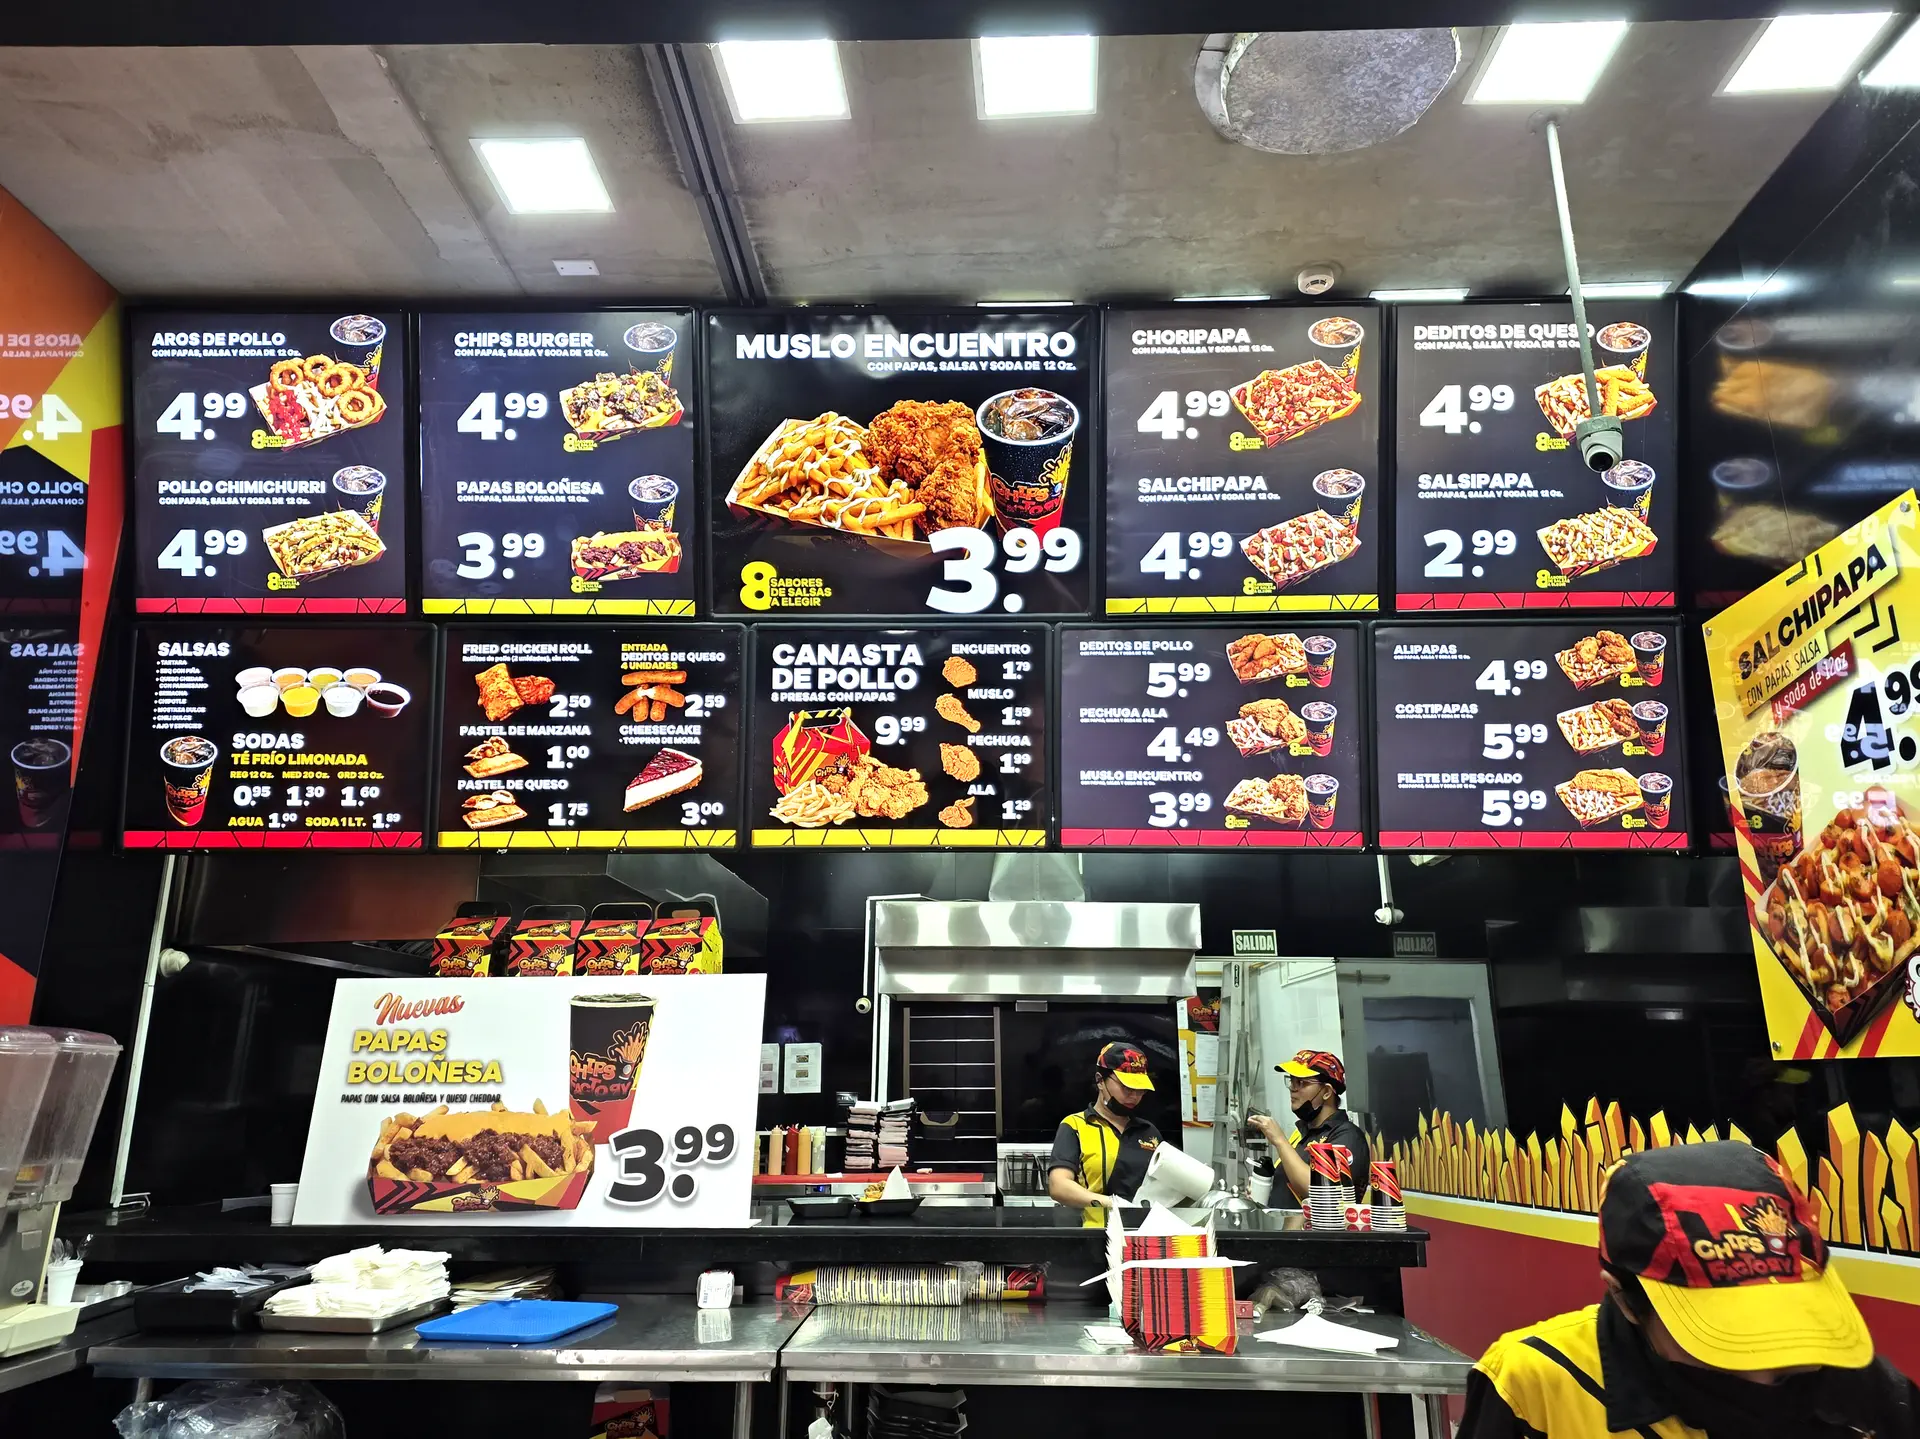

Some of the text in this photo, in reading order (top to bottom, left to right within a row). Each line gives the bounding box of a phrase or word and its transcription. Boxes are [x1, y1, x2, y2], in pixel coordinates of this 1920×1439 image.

[1132, 328, 1251, 346] CHORIPAPA
[1414, 323, 1594, 341] DEDITOS DE QUESO
[152, 333, 286, 346] AROS DE POLLO
[455, 333, 594, 347] CHIPS BURGER
[737, 331, 1075, 360] MUSLO ENCUENTRO
[867, 362, 893, 372] CON
[895, 360, 938, 372] PAPAS,
[939, 361, 977, 371] SALSA
[979, 361, 988, 370] Y
[990, 361, 1022, 371] SODA
[1024, 361, 1040, 370] DE
[1044, 361, 1056, 370] 12
[159, 481, 326, 494] POLLO CHIMICHURRI
[457, 478, 604, 494] PAPAS BOLOÑESA
[1138, 476, 1267, 494] SALCHIPAPA
[1418, 473, 1533, 489] SALSIPAPA
[740, 562, 777, 610] 8
[771, 579, 823, 587] SABORES
[770, 588, 832, 598] DE SALSAS
[770, 597, 820, 606] A ELEGIR
[1738, 543, 1887, 680] SALCHIPAPA
[158, 642, 230, 656] SALSAS
[463, 644, 592, 654] FRIED CHICKEN ROLL
[952, 644, 1031, 654] ENCUENTRO
[1080, 641, 1193, 652] DEDITOS DE POLLO
[1394, 645, 1457, 656] ALIPAPAS
[621, 652, 725, 662] DEDITOS DE QUESO
[773, 644, 923, 666] CANASTA
[629, 662, 677, 671] UNIDADES
[772, 668, 918, 690] DE POLLO
[1746, 686, 1763, 707] CON
[1796, 641, 1821, 672] SALSA
[771, 692, 895, 702] 8 PRESAS CON PAPAS
[968, 689, 1014, 699] MUSLO
[1774, 700, 1782, 718] y
[1784, 684, 1807, 707] soda
[1809, 672, 1822, 689] de
[1080, 708, 1168, 719] PECHUGA ALA
[1395, 704, 1478, 716] COSTIPAPAS
[460, 725, 591, 738] PASTEL DE MANZANA
[619, 725, 701, 735] CHEESECAKE
[232, 733, 304, 749] SODAS
[966, 735, 1031, 746] PECHUGA
[231, 751, 368, 765] TÉ FRÍO LIMONADA
[1080, 771, 1202, 783] MUSLO ENCUENTRO
[1398, 773, 1522, 785] FILETE DE PESCADO
[458, 780, 568, 791] PASTEL DE QUESO
[967, 785, 995, 795] ALA
[228, 817, 264, 826] AGUA
[305, 817, 339, 826] SODA
[341, 817, 346, 826] 1
[1234, 934, 1273, 951] SALIDA
[374, 992, 464, 1026] Nuevas
[352, 1029, 448, 1053] PAPAS
[346, 1054, 503, 1084] BOLOÑESA
[340, 1092, 501, 1104] PAPAS CON SALSA BOLOÑESA Y QUESO CHEDDAR
[609, 1123, 734, 1202] 3.99
[1693, 1234, 1765, 1260] CHIPS
